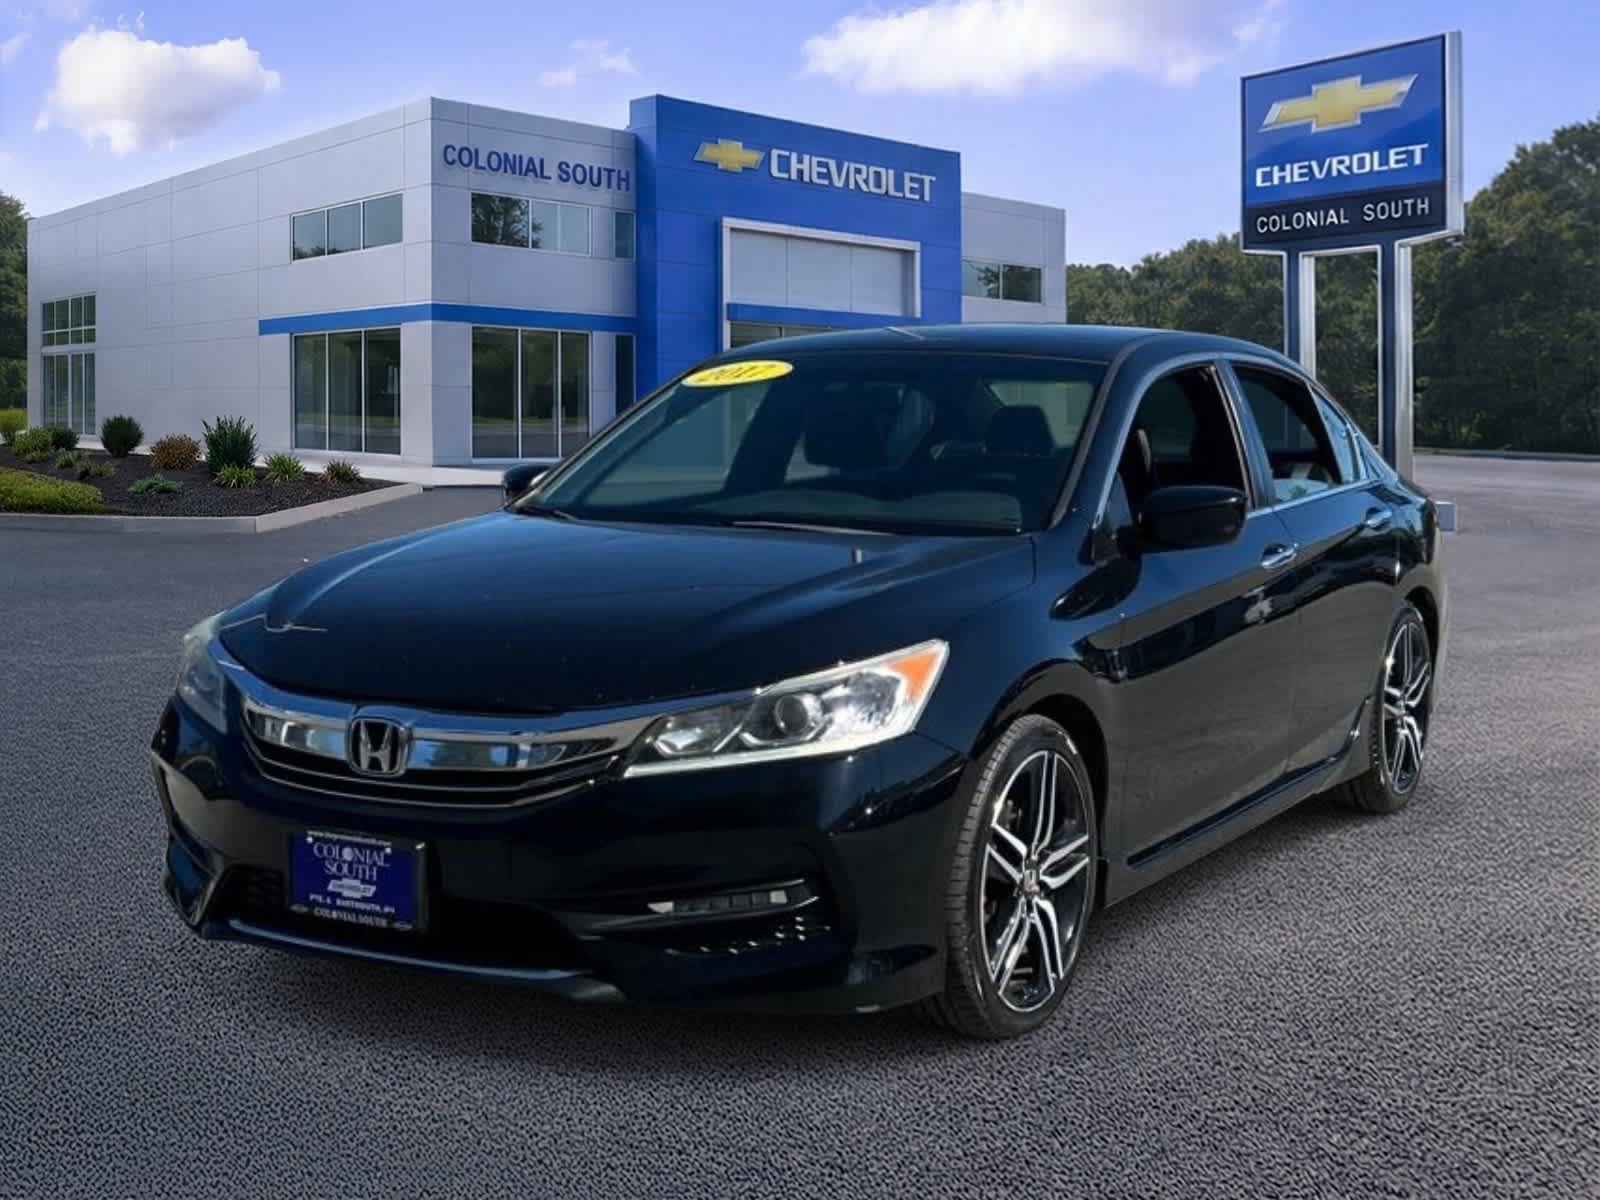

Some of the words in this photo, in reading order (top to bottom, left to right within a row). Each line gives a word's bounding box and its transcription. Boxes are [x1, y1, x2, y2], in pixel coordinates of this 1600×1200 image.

[443, 144, 552, 180] COLONIAL
[557, 161, 631, 192] SOUTH
[770, 148, 937, 203] CHEVROLET
[1255, 143, 1429, 187] CHEVROLET
[1256, 207, 1349, 234] COLONIAL
[1363, 197, 1430, 222] SOUTH
[313, 841, 390, 867] COLONIAL
[324, 859, 377, 881] SOUTH
